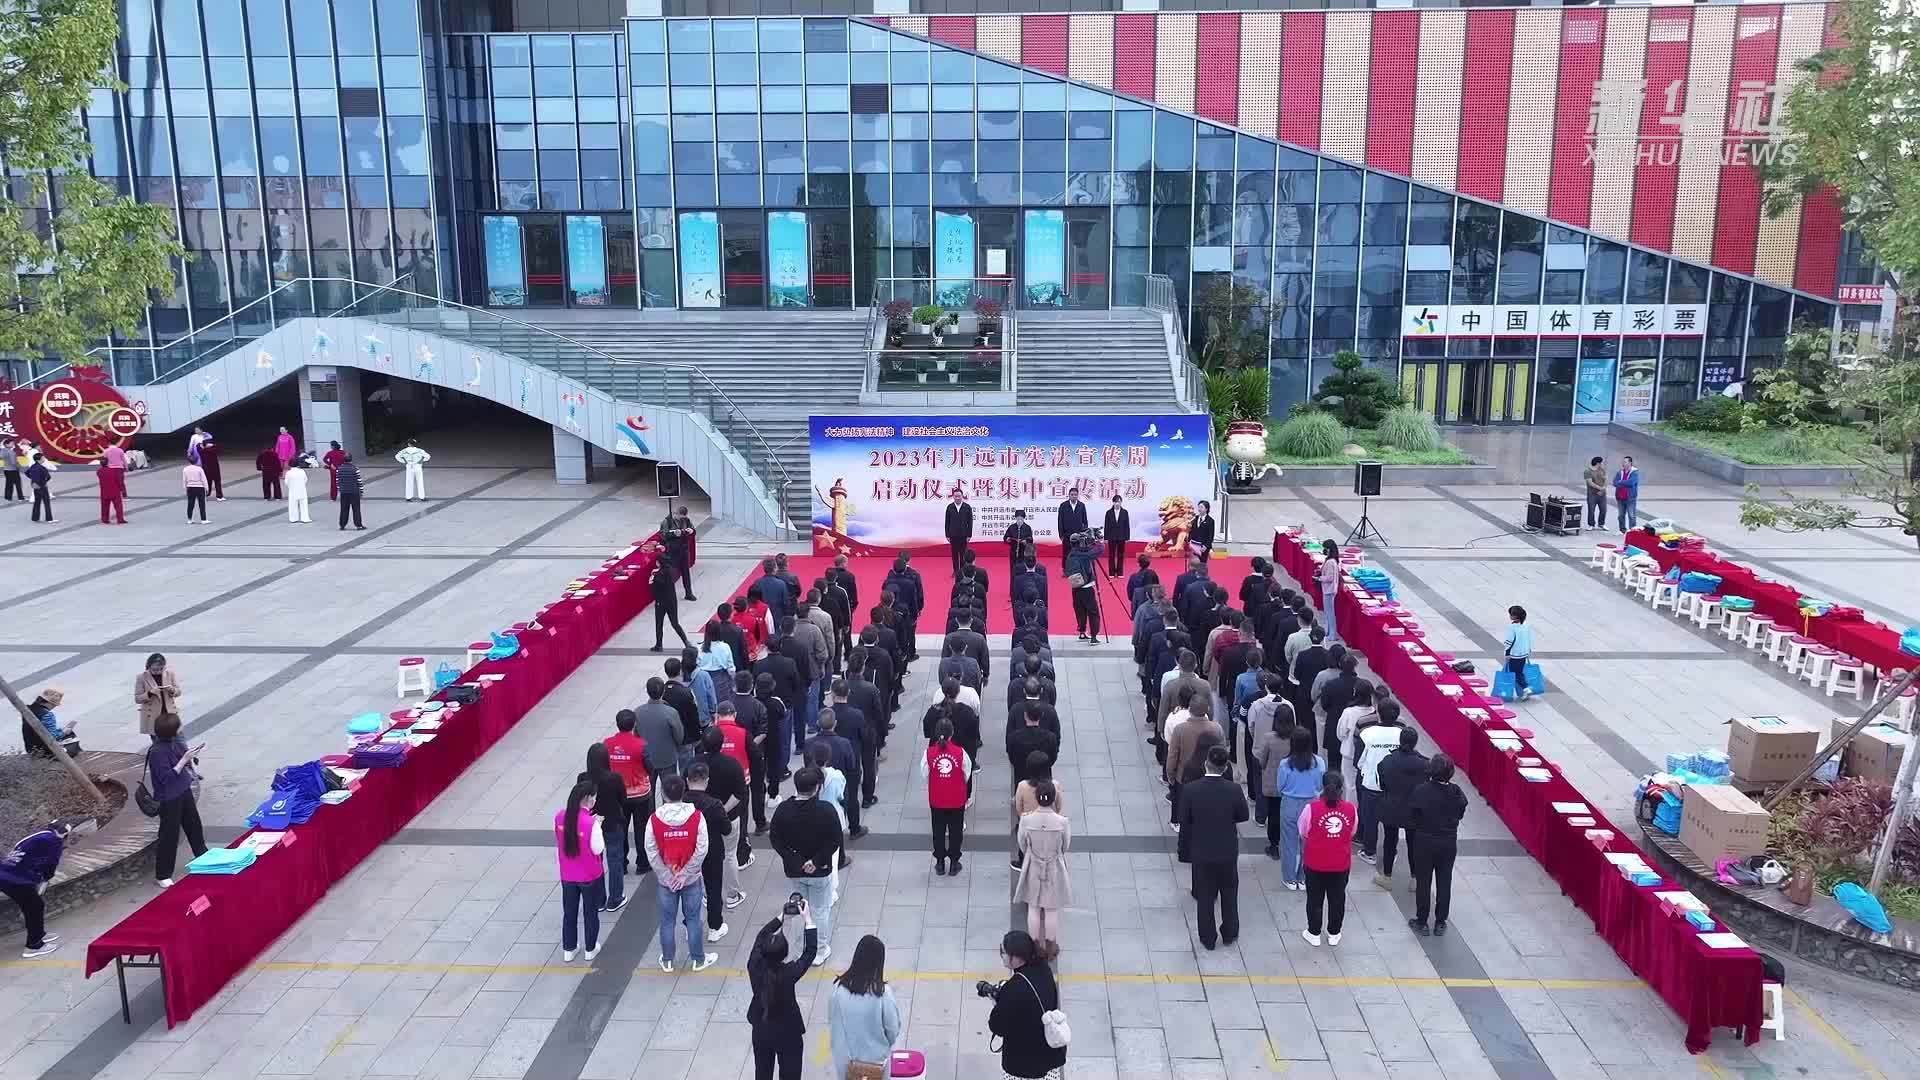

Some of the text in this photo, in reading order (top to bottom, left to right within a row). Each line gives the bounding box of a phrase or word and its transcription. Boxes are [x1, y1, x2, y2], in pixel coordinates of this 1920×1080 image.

[1461, 309, 1697, 332] 中国体育彩票
[824, 426, 990, 438] 大力弘扬宪法精神 建设社会主义法治文化
[869, 444, 1149, 470] 2023年开远市宪法宣传周
[871, 477, 1148, 502] 启动仪式暨集中宣传活动
